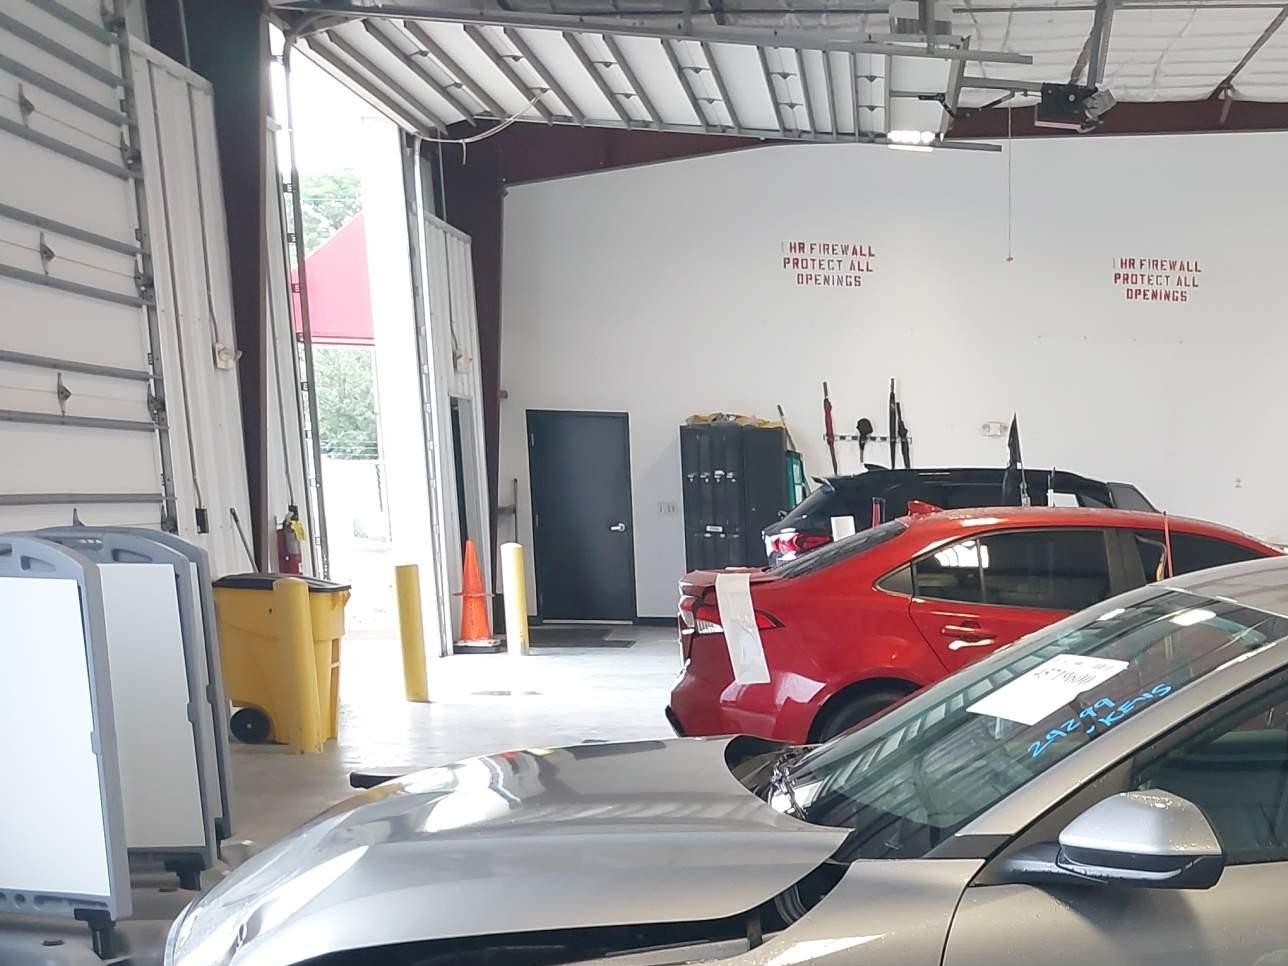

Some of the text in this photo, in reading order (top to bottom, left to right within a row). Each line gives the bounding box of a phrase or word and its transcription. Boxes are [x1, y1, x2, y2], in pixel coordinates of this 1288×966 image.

[789, 242, 806, 254] HR
[809, 243, 875, 257] FIREWALL
[783, 257, 873, 272] PROTECT ALL
[1120, 258, 1136, 270] HR
[1139, 259, 1202, 273] FIREWALL
[796, 273, 862, 287] OPENINGS
[1113, 273, 1199, 287] PROTECT ALL
[1126, 288, 1187, 302] OPENINGS
[1027, 697, 1116, 757] 29299
